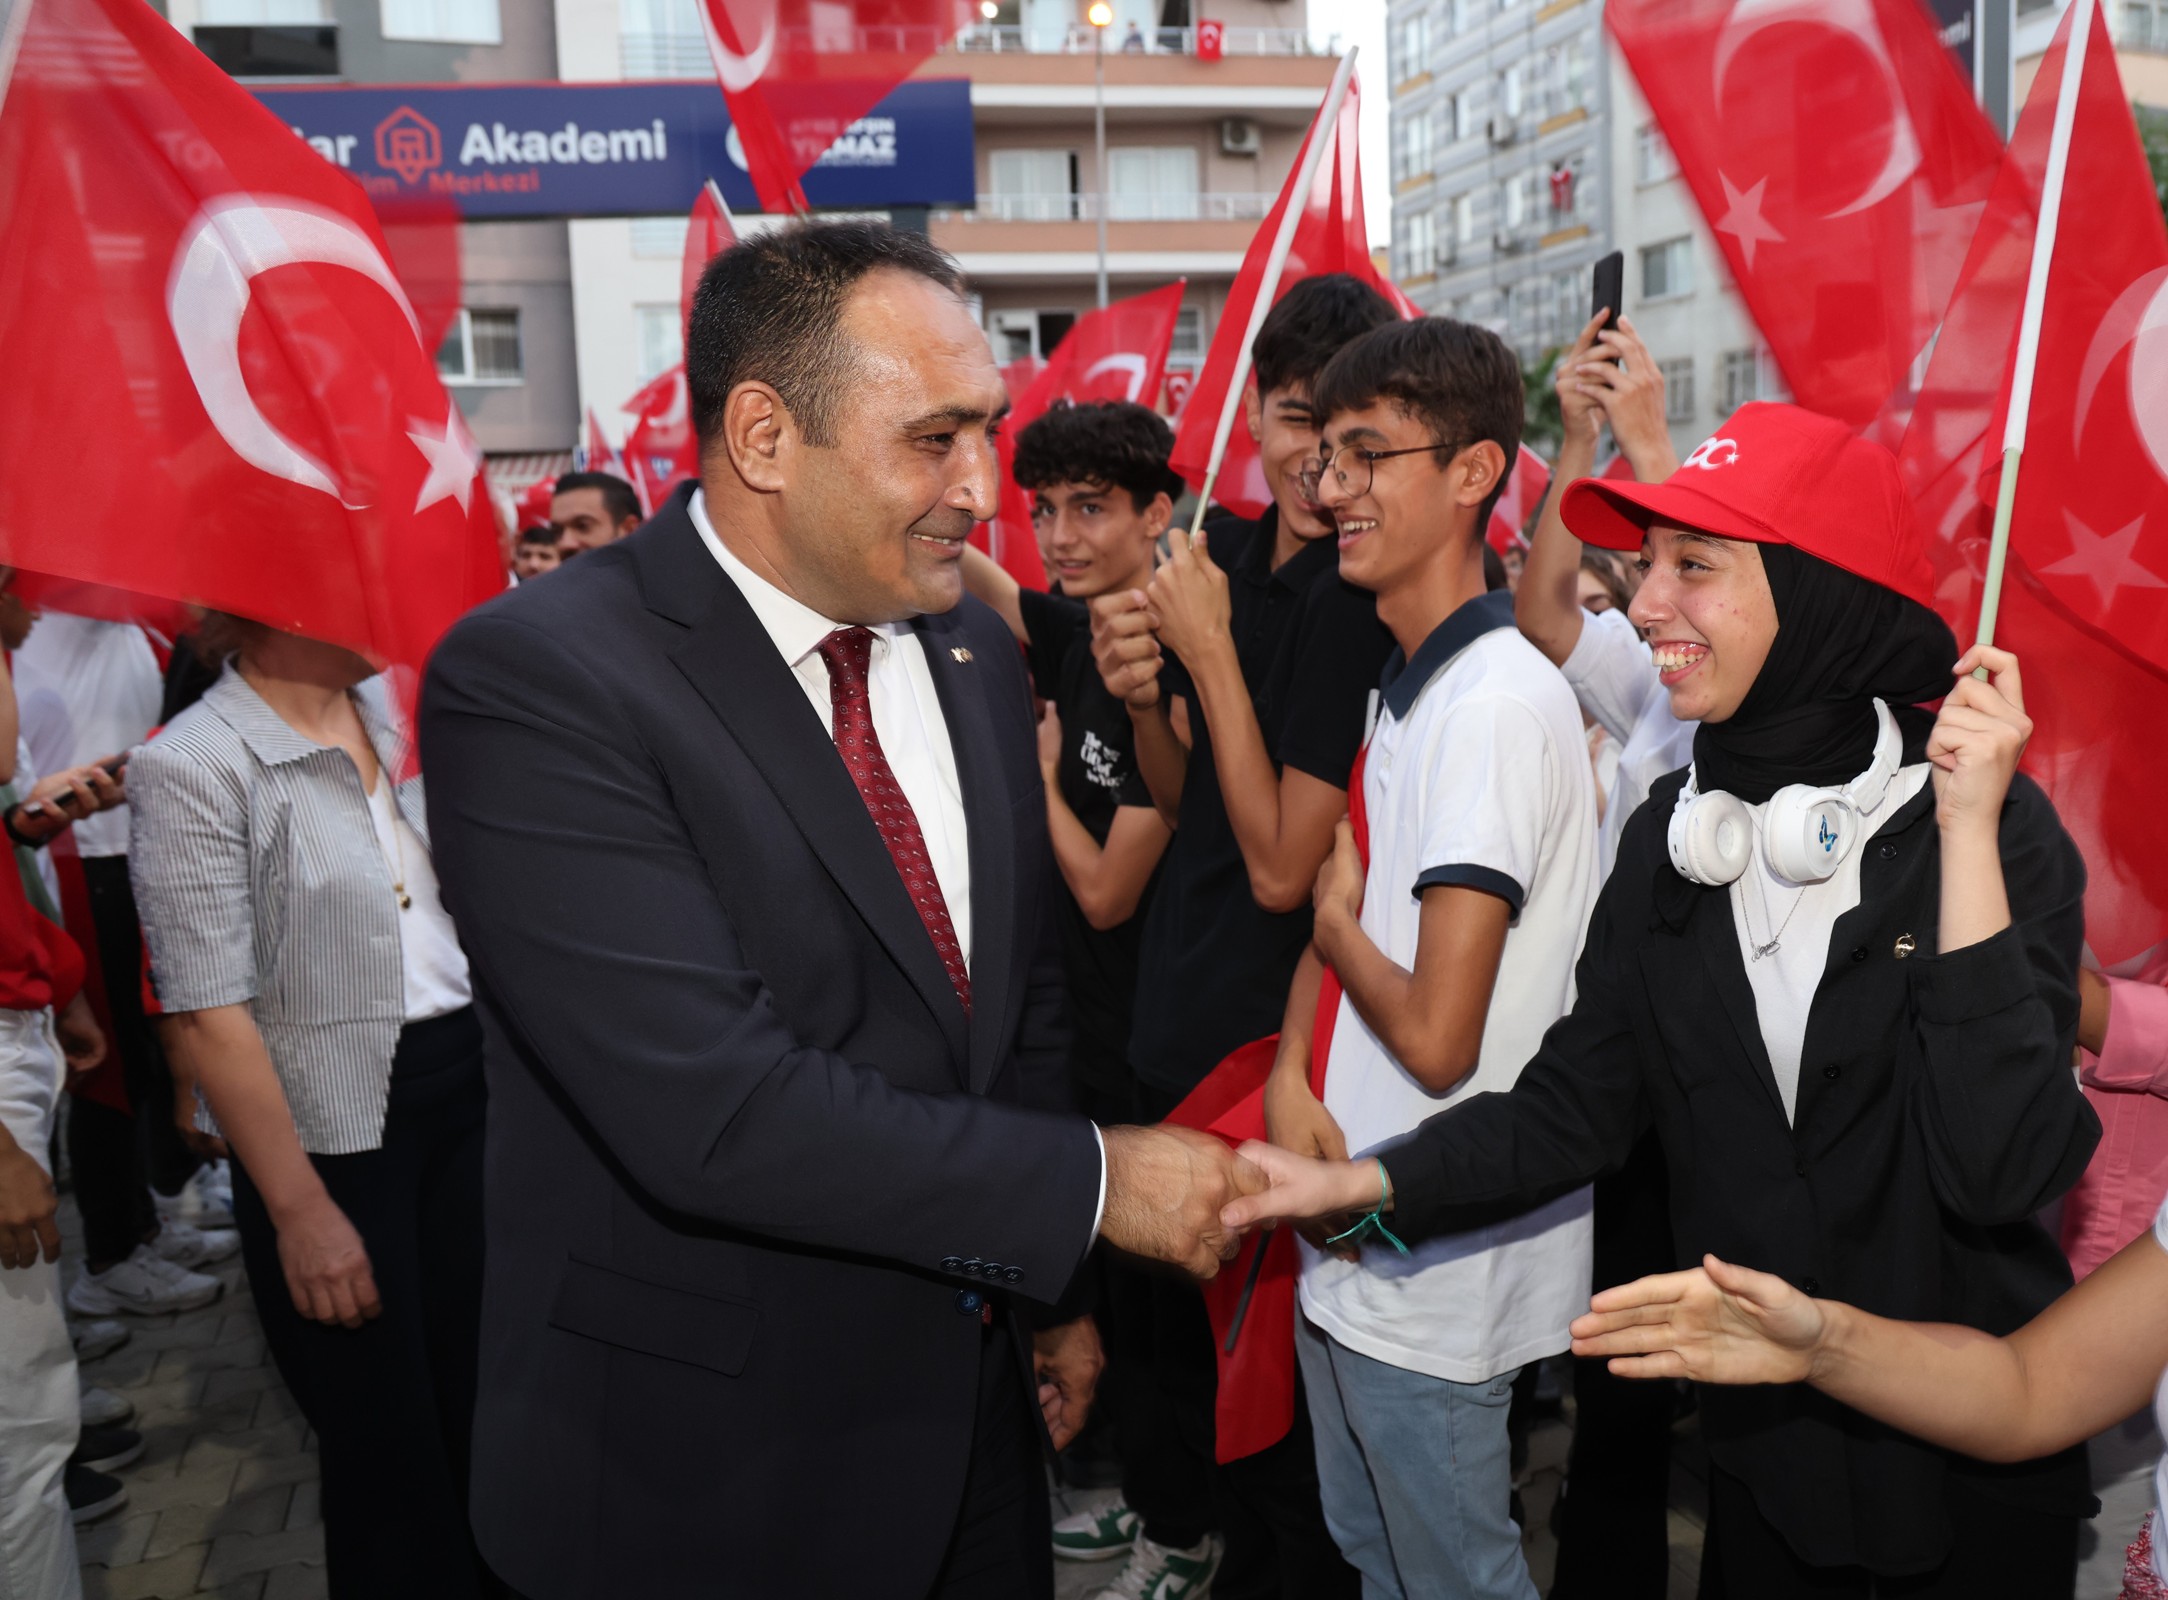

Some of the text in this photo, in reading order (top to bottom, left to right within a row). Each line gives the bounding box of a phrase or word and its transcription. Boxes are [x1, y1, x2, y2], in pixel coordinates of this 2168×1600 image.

[459, 118, 667, 166] Akademi
[428, 168, 540, 194] Merkezi
[1085, 730, 1102, 750] The
